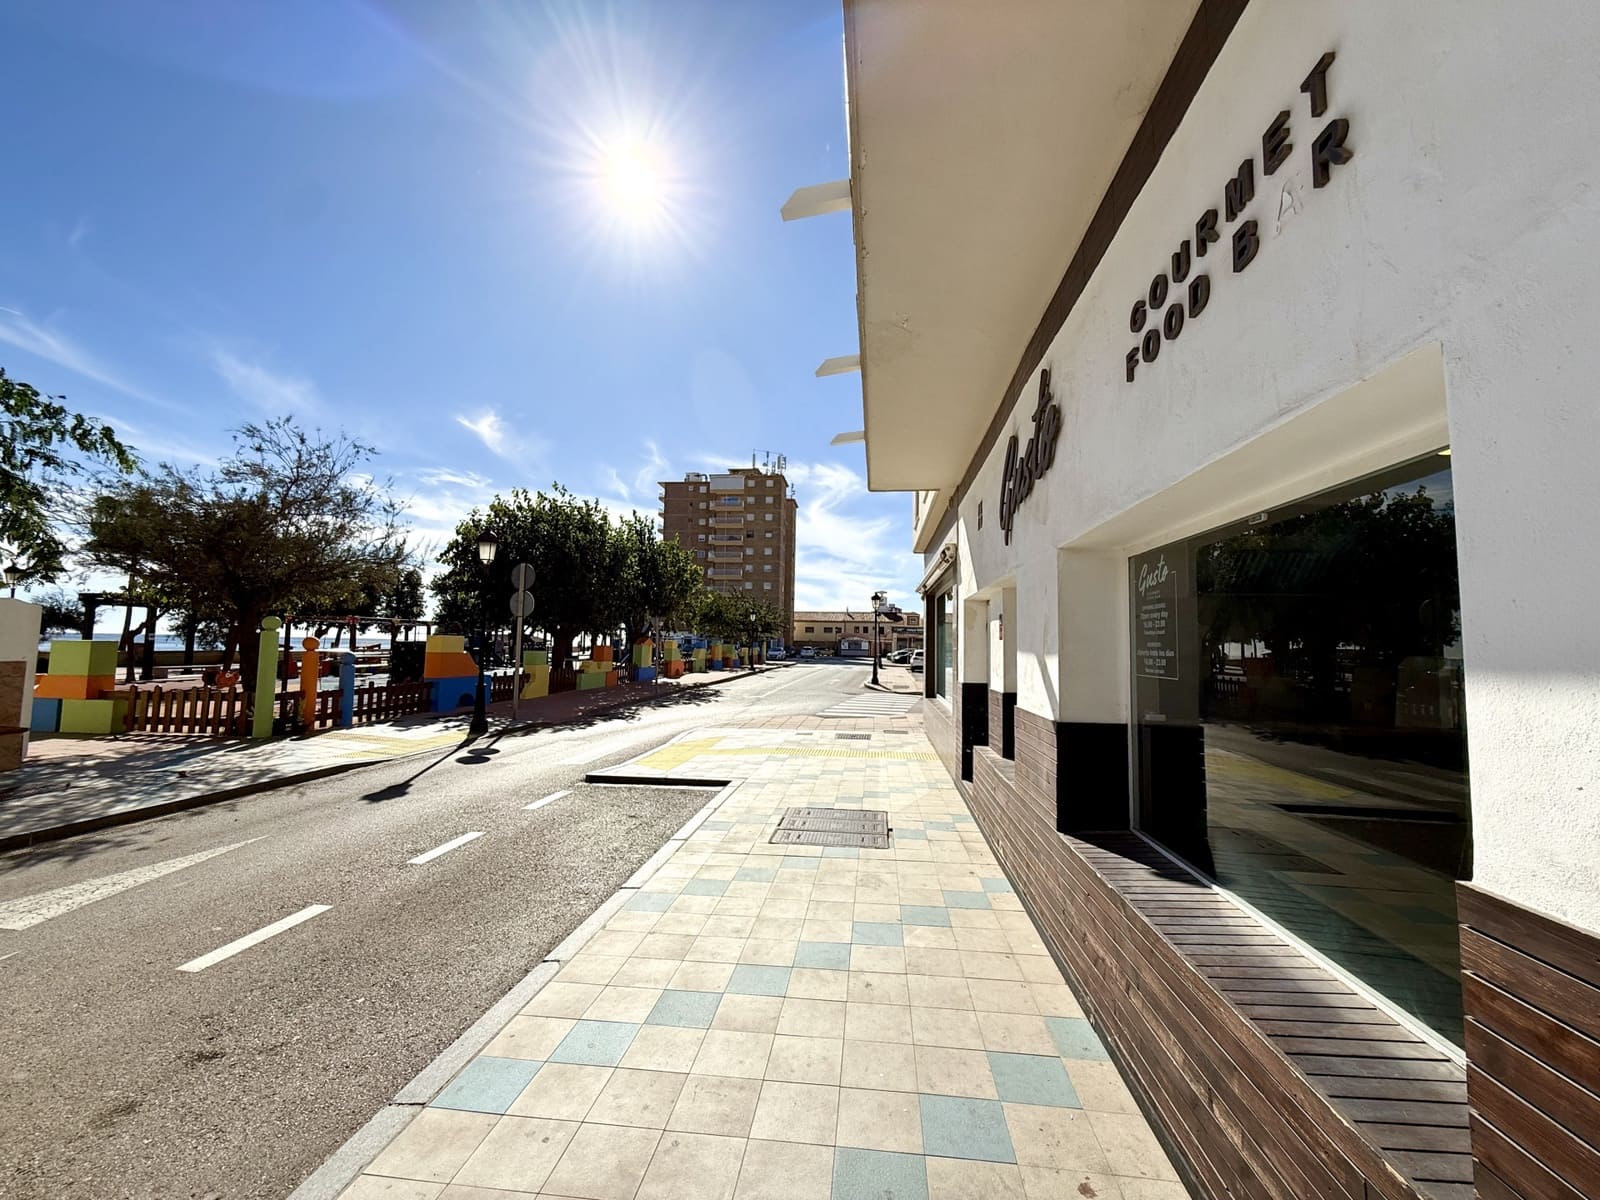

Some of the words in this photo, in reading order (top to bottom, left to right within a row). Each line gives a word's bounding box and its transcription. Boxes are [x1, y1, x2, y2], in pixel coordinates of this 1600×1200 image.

[1130, 51, 1336, 332] GOURMET
[1126, 274, 1211, 383] FOOD
[1000, 368, 1061, 546] Gusto
[1138, 554, 1169, 597] Gusto
